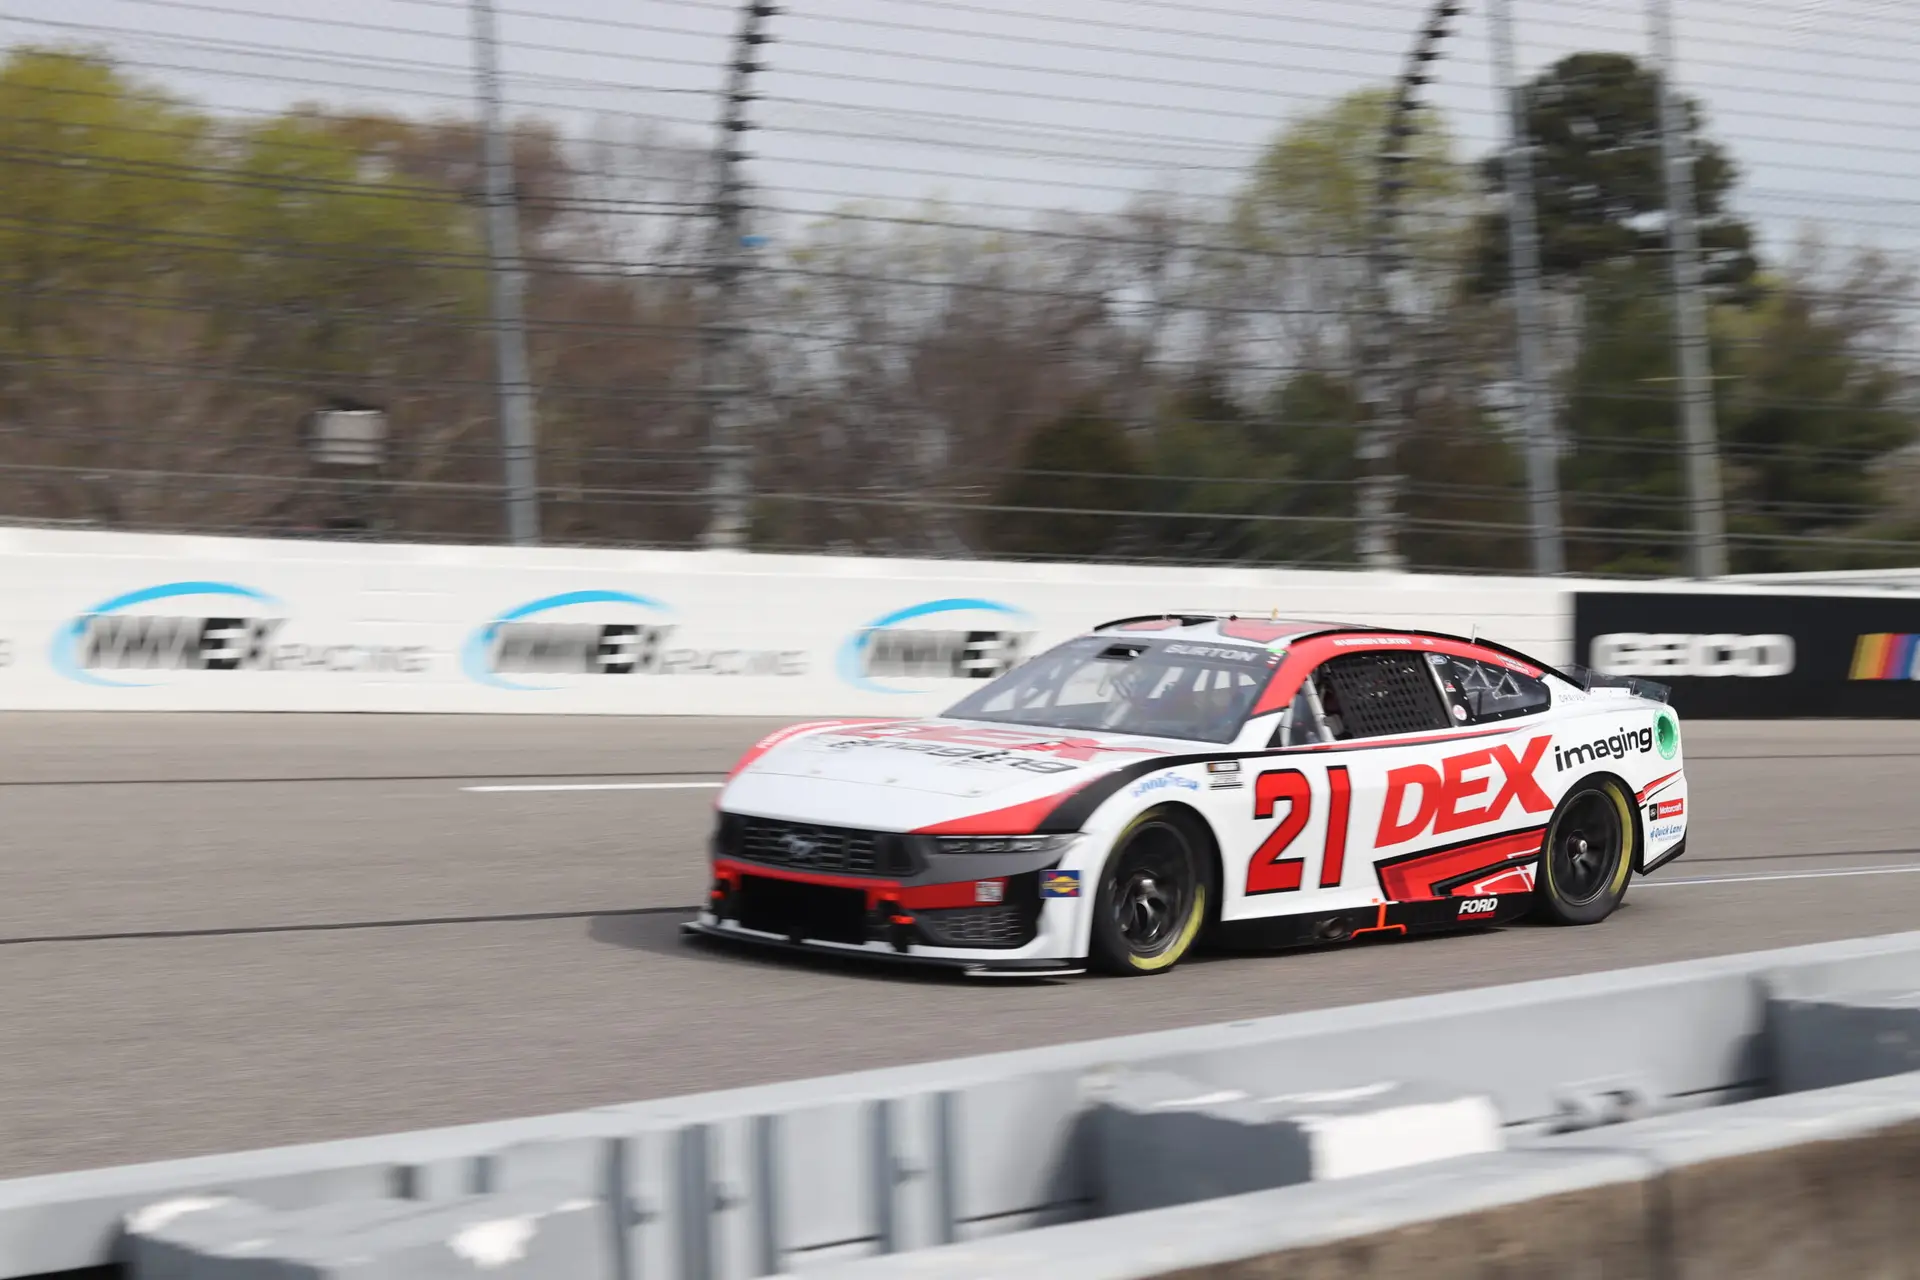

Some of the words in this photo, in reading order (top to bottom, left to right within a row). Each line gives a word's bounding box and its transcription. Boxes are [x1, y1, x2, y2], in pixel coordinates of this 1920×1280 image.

[660, 648, 808, 676] RACG
[1591, 633, 1796, 677] GEICO
[1555, 727, 1652, 772] imaging
[1374, 735, 1555, 848] DEX
[1245, 766, 1352, 897] 21
[1458, 898, 1498, 914] FORD
